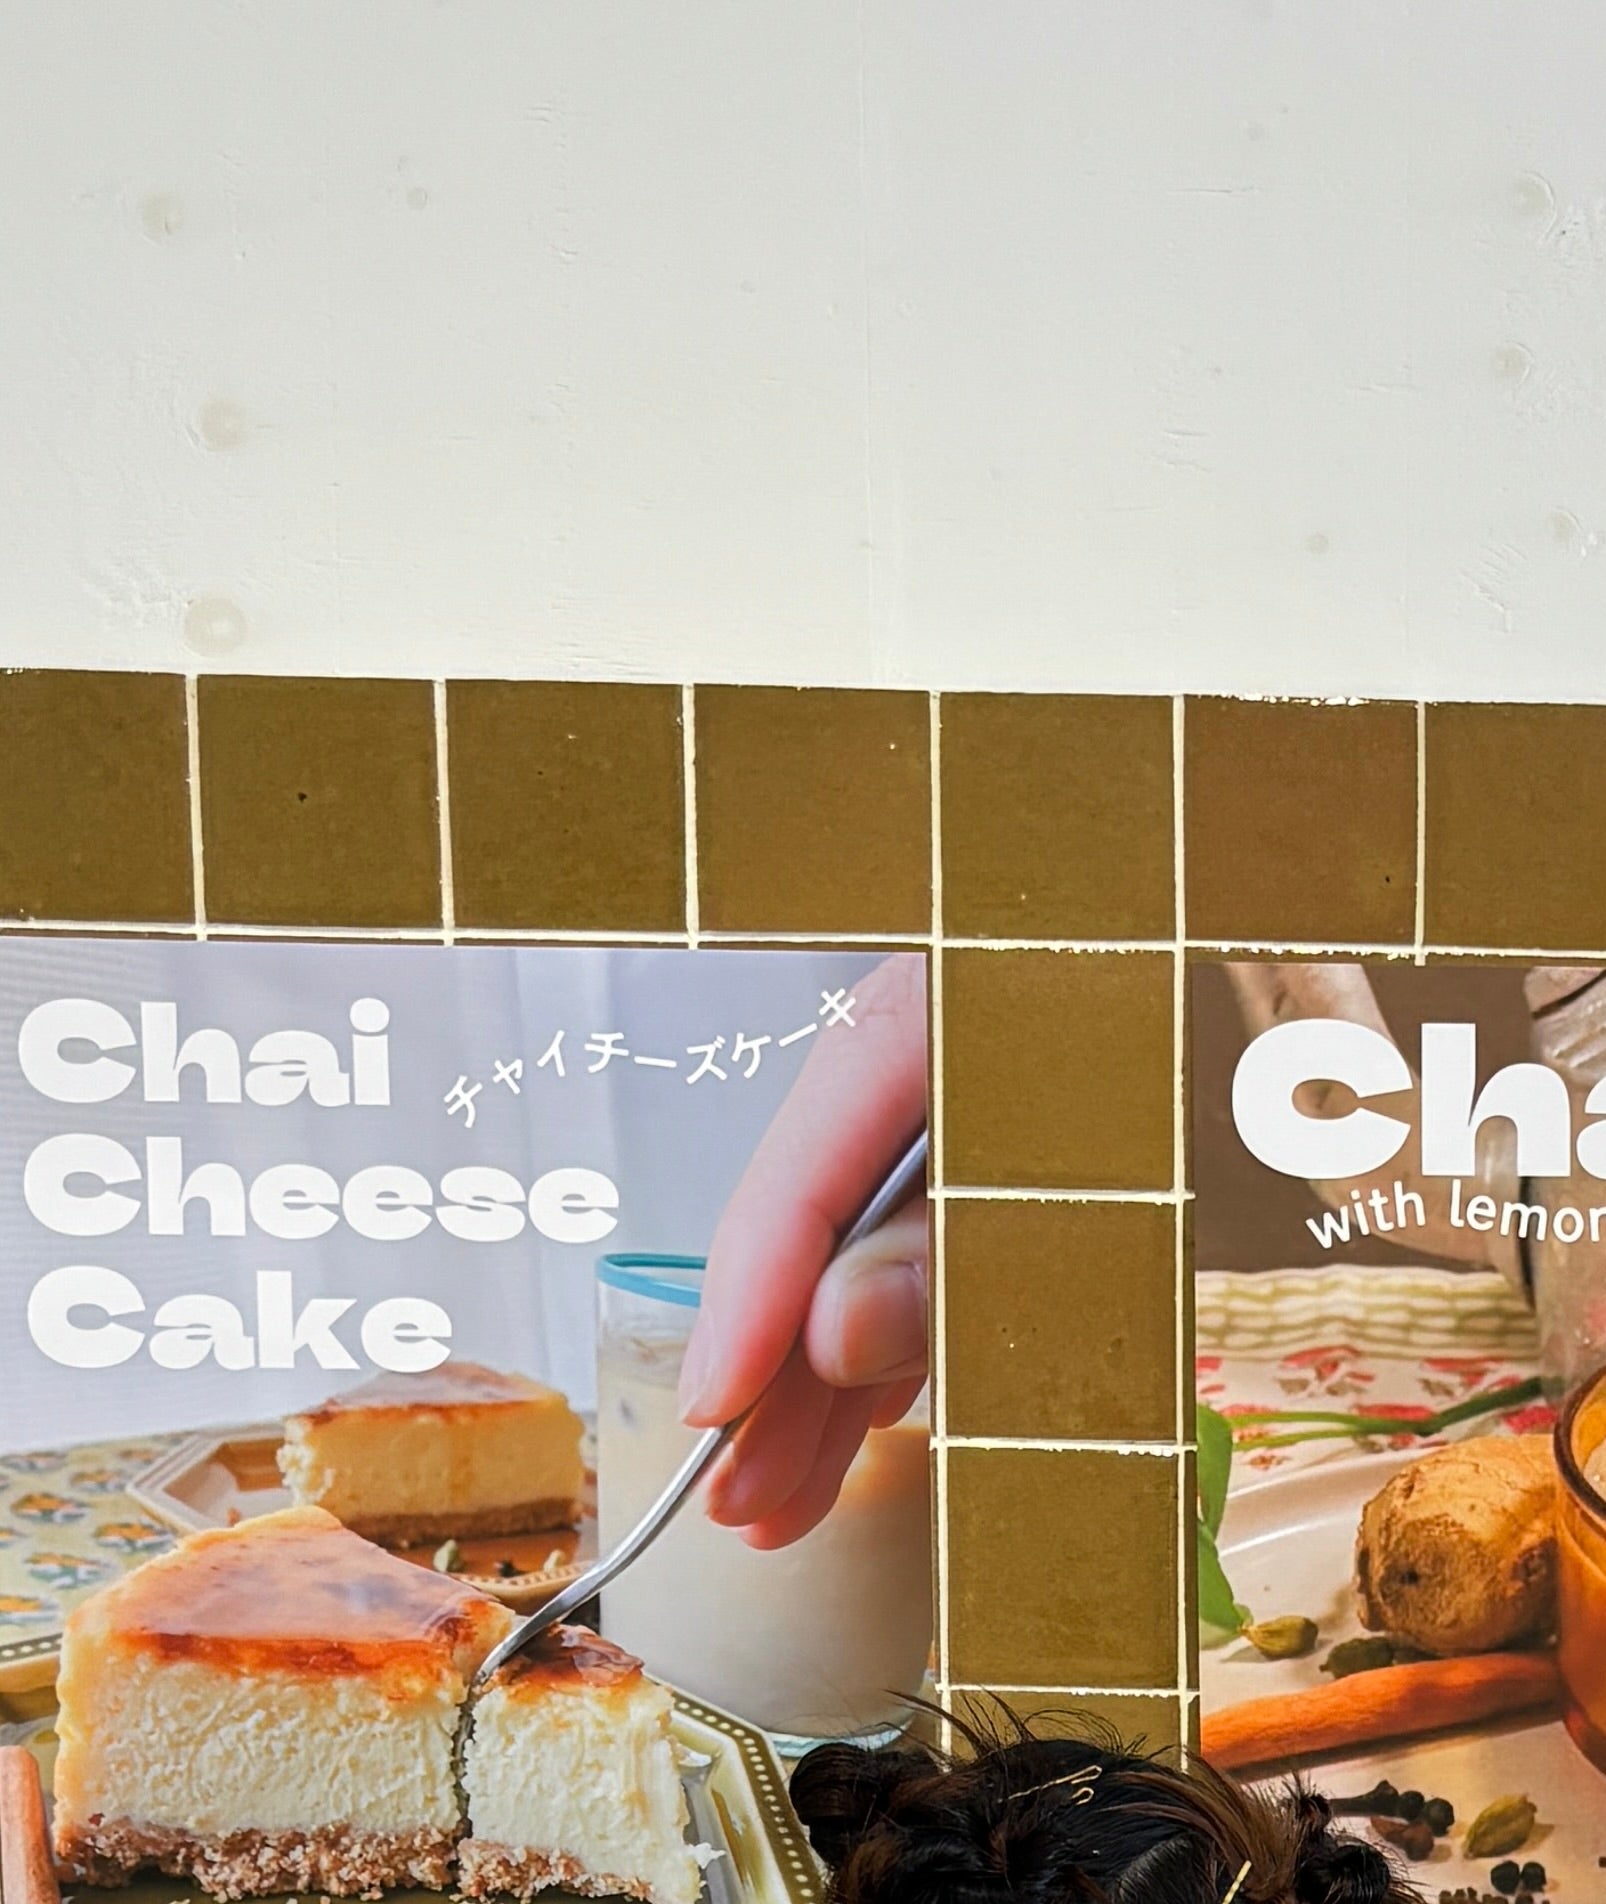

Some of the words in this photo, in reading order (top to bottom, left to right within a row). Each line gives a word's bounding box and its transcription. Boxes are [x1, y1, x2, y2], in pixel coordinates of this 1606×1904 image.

[18, 997, 391, 1106] Chai
[443, 988, 858, 1128] チャイチーズケーキ
[24, 1133, 619, 1244] Cheese
[1305, 1180, 1426, 1250] with
[27, 1264, 452, 1373] Cake
